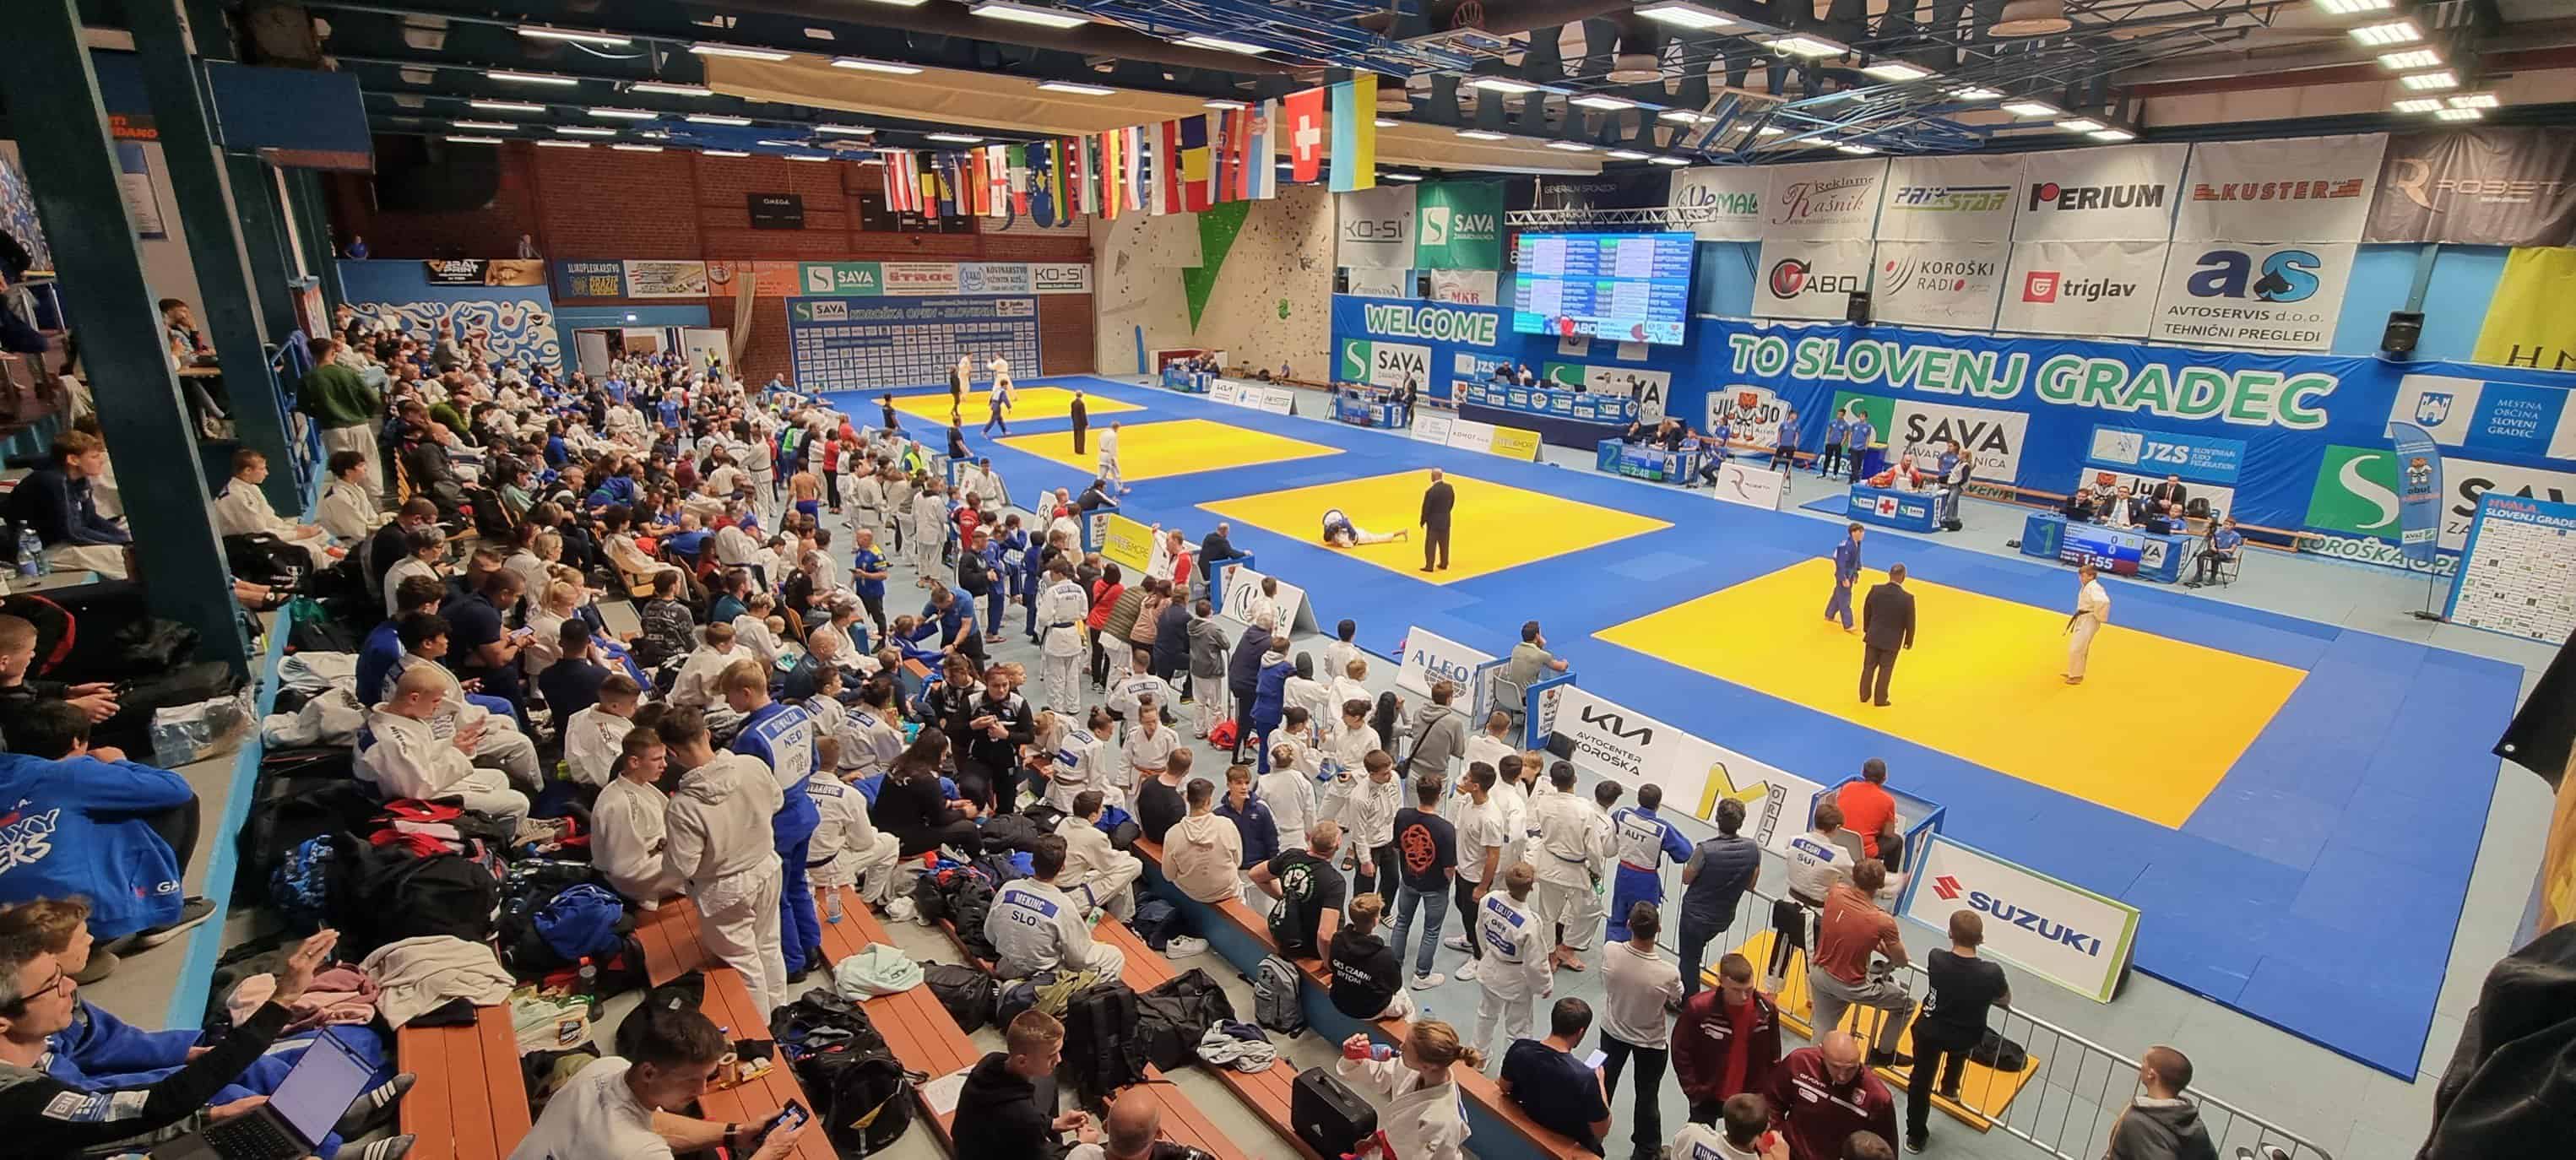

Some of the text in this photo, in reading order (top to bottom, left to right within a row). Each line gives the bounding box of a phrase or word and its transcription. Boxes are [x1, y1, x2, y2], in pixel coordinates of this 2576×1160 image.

[2028, 182, 2166, 211] PERIUM
[2221, 180, 2331, 201] KUSTER
[1453, 214, 1495, 233] SAVA
[837, 270, 874, 284] SAVA
[1034, 268, 1083, 281] KO-SI
[1920, 260, 1994, 276] KOROŠKI
[2064, 278, 2137, 302] triglav
[816, 305, 845, 314] SAVA
[2167, 306, 2324, 323] AVTOSERVIS d.o.o.
[1365, 304, 1499, 346] WELCOME
[2164, 323, 2321, 342] TEHNIČNI PREGLEDI
[1378, 350, 1426, 374] SAVA
[1729, 334, 2339, 431] TO SLOVENJ GRADEC
[2497, 398, 2542, 412] MESTNA
[2487, 426, 2535, 439] GRADEC
[2491, 417, 2537, 430] SLOVENJ
[1904, 413, 2009, 455] SAVA
[1903, 445, 2007, 469] ZAVARNICA
[2141, 442, 2189, 464] JZS
[2485, 507, 2535, 523] SLOVENJ
[2082, 554, 2114, 569] 1:55
[1581, 705, 1653, 746] KIA
[784, 729, 803, 749] NED
[1576, 731, 1642, 763] AVTOCENTER
[1624, 828, 1647, 843] AUT
[1797, 852, 1816, 867] SUI
[1011, 910, 1037, 927] SLO
[1967, 890, 2102, 958] SUZUKI
